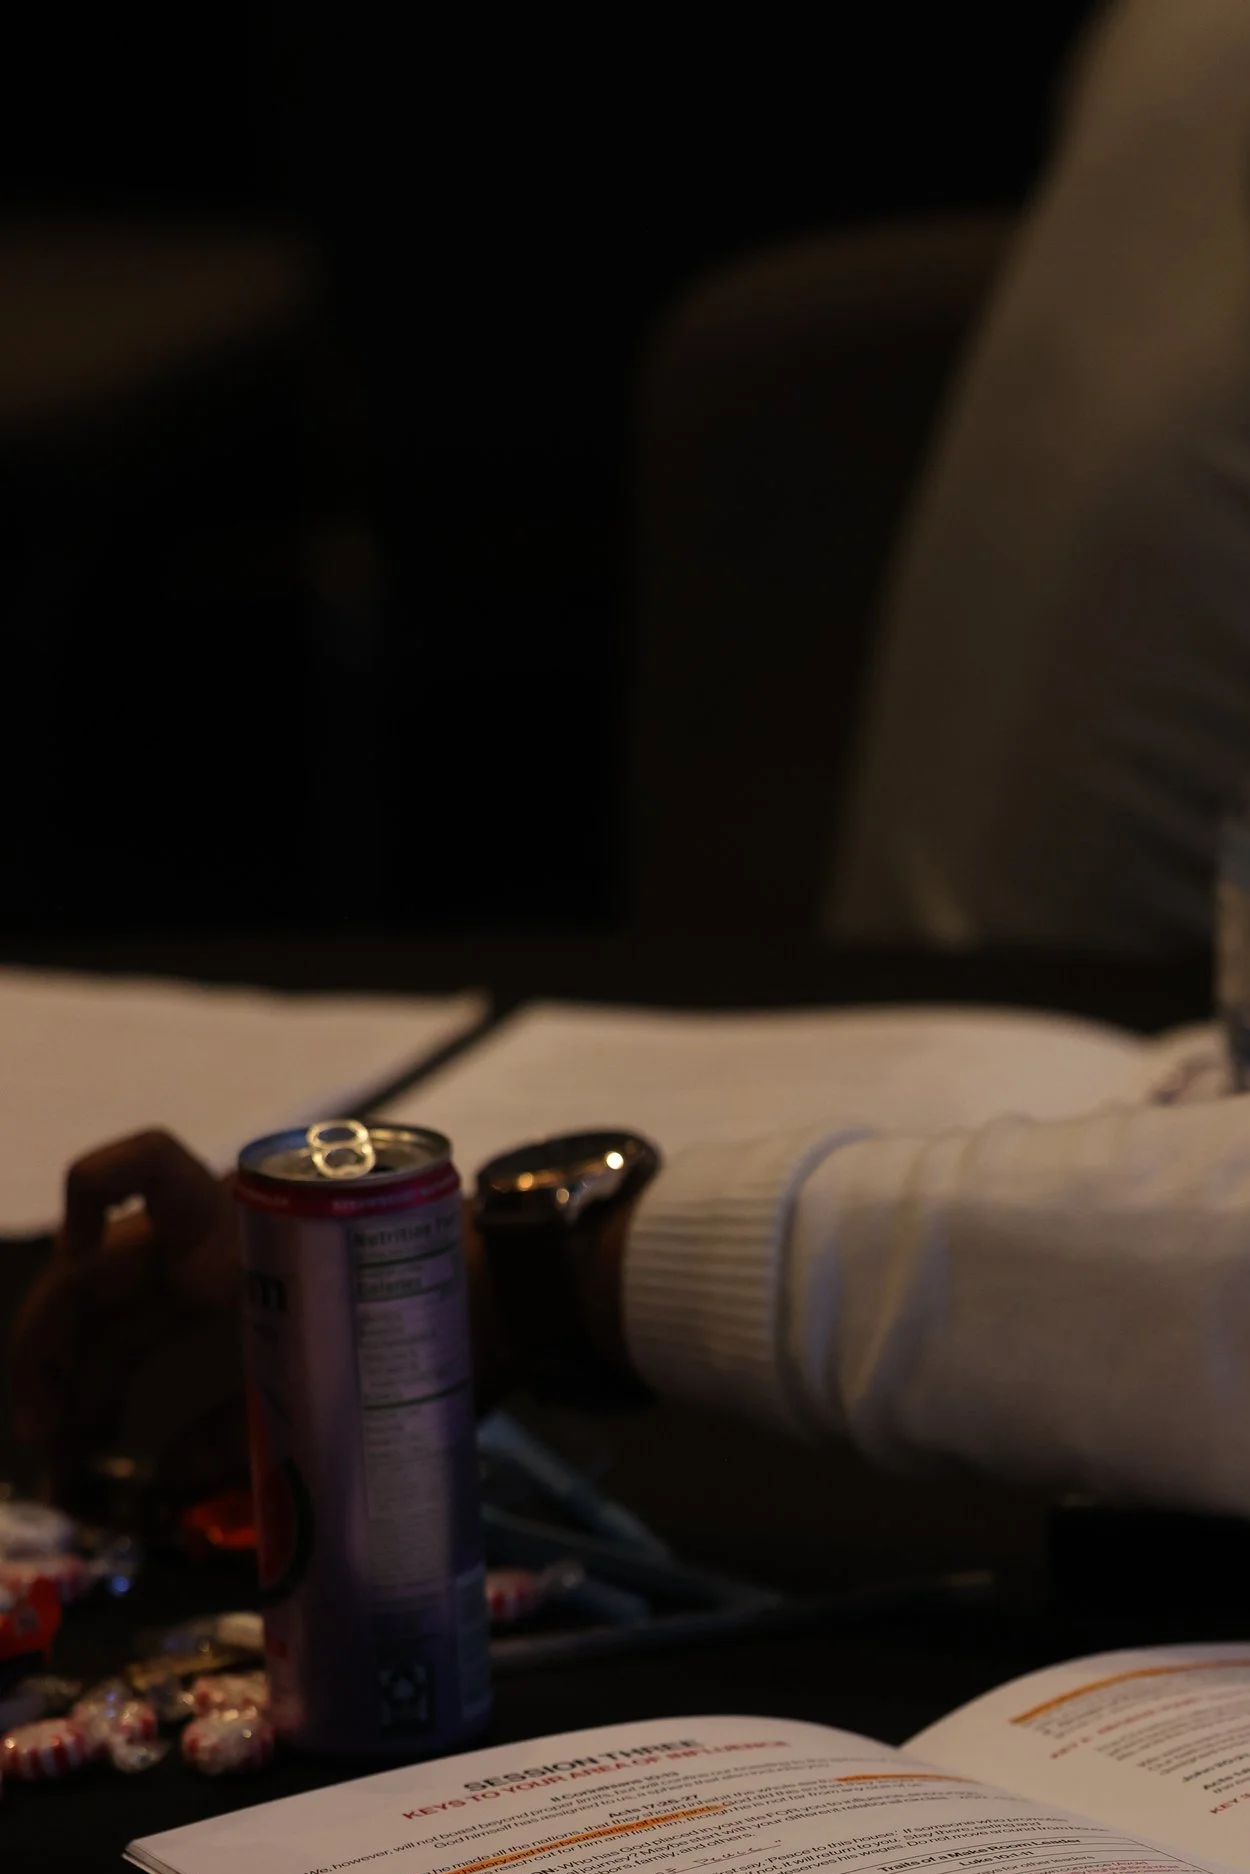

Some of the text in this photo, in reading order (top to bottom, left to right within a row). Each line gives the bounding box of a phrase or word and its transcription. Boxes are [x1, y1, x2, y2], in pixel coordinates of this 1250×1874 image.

[464, 1739, 702, 1792] SESSION THREE
[402, 1800, 466, 1819] KEYS
[467, 1791, 500, 1802] TO
[502, 1775, 565, 1794] YOUR
[570, 1761, 629, 1779] AREA
[609, 1809, 641, 1818] Acts
[432, 1867, 451, 1874] he
[452, 1855, 490, 1869] made
[492, 1849, 507, 1857] all
[508, 1844, 530, 1853] the
[532, 1831, 584, 1846] nations,
[578, 1853, 638, 1874] journey?
[639, 1841, 688, 1856] Maybe
[739, 1862, 765, 1871] say,
[877, 1862, 922, 1874] Traits
[947, 1848, 988, 1860] Make
[959, 1856, 994, 1867] Luke
